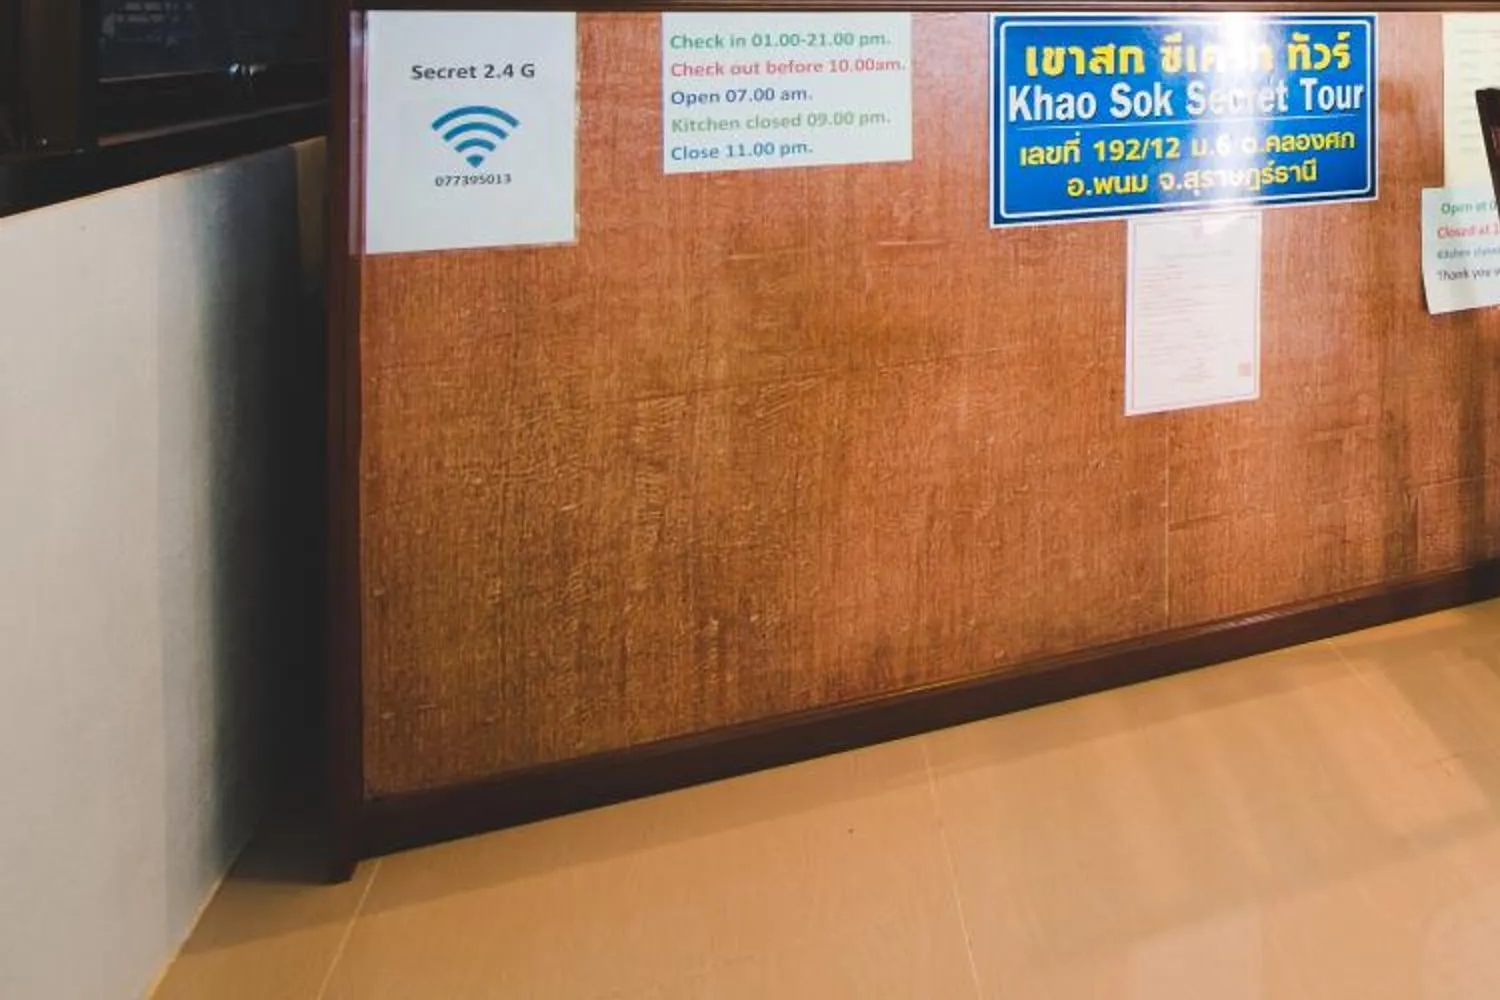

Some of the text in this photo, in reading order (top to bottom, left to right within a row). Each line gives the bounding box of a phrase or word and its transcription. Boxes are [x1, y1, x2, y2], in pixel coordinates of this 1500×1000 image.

[670, 32, 891, 50] Check in 01.00-21.00 pm.
[670, 61, 724, 77] Check
[730, 62, 760, 76] out
[766, 59, 824, 75] before
[1024, 42, 1146, 77] เขาสก
[411, 63, 536, 80] Secret 2.4 G
[671, 87, 813, 107] Open 07.00 am.
[1008, 83, 1097, 122] Khao
[1109, 81, 1174, 119] Sok
[1299, 77, 1365, 112] Tour
[671, 111, 892, 133] Kitchen closed 09.00 pm.
[671, 142, 813, 161] Close 11.00 pm.
[1093, 137, 1181, 163] 192/12
[1067, 172, 1148, 197] อ.พนม
[1441, 201, 1473, 216] Open
[1437, 267, 1469, 281] Thank
